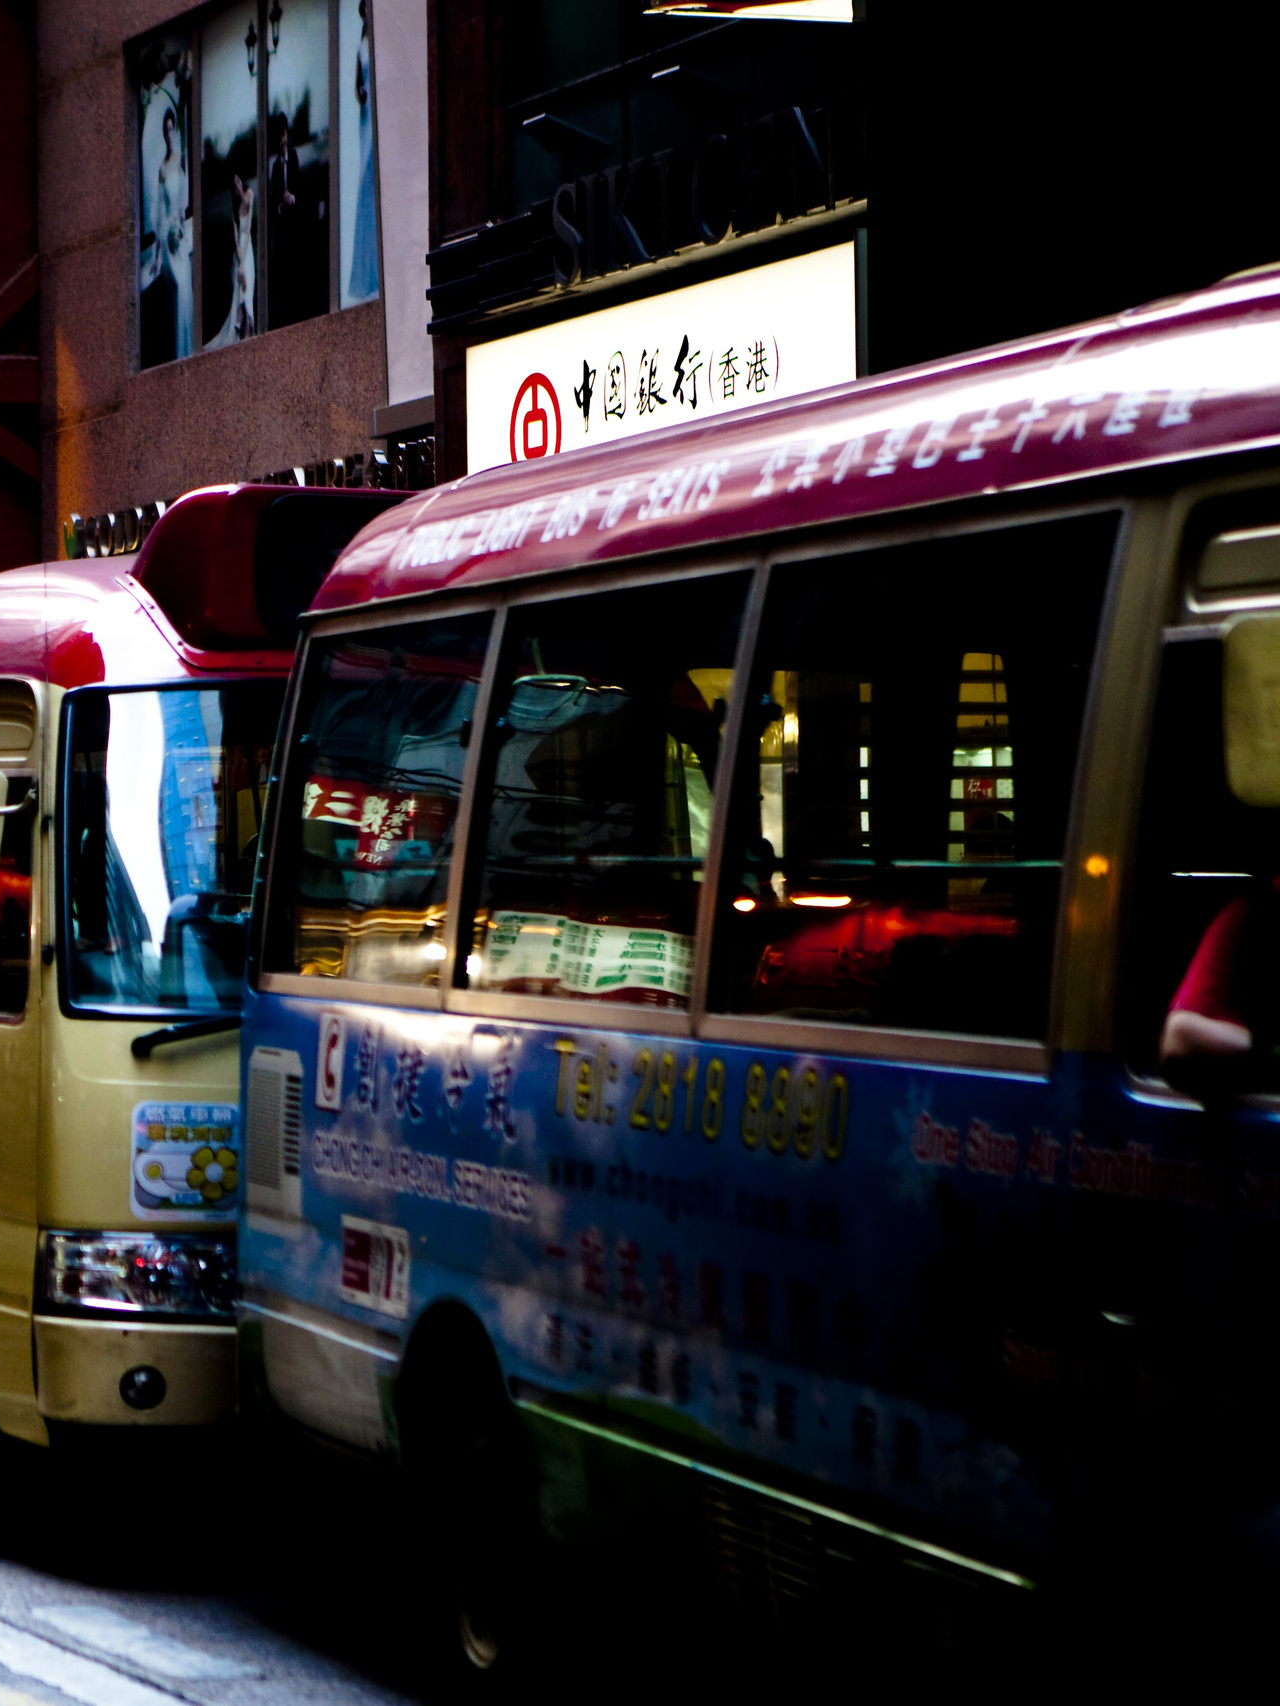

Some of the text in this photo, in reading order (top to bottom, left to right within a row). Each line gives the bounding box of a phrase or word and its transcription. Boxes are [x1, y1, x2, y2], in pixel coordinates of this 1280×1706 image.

[541, 489, 596, 543] BUS
[636, 460, 731, 522] SEATS
[628, 1046, 727, 1142] 2818
[740, 1060, 850, 1162] 8890
